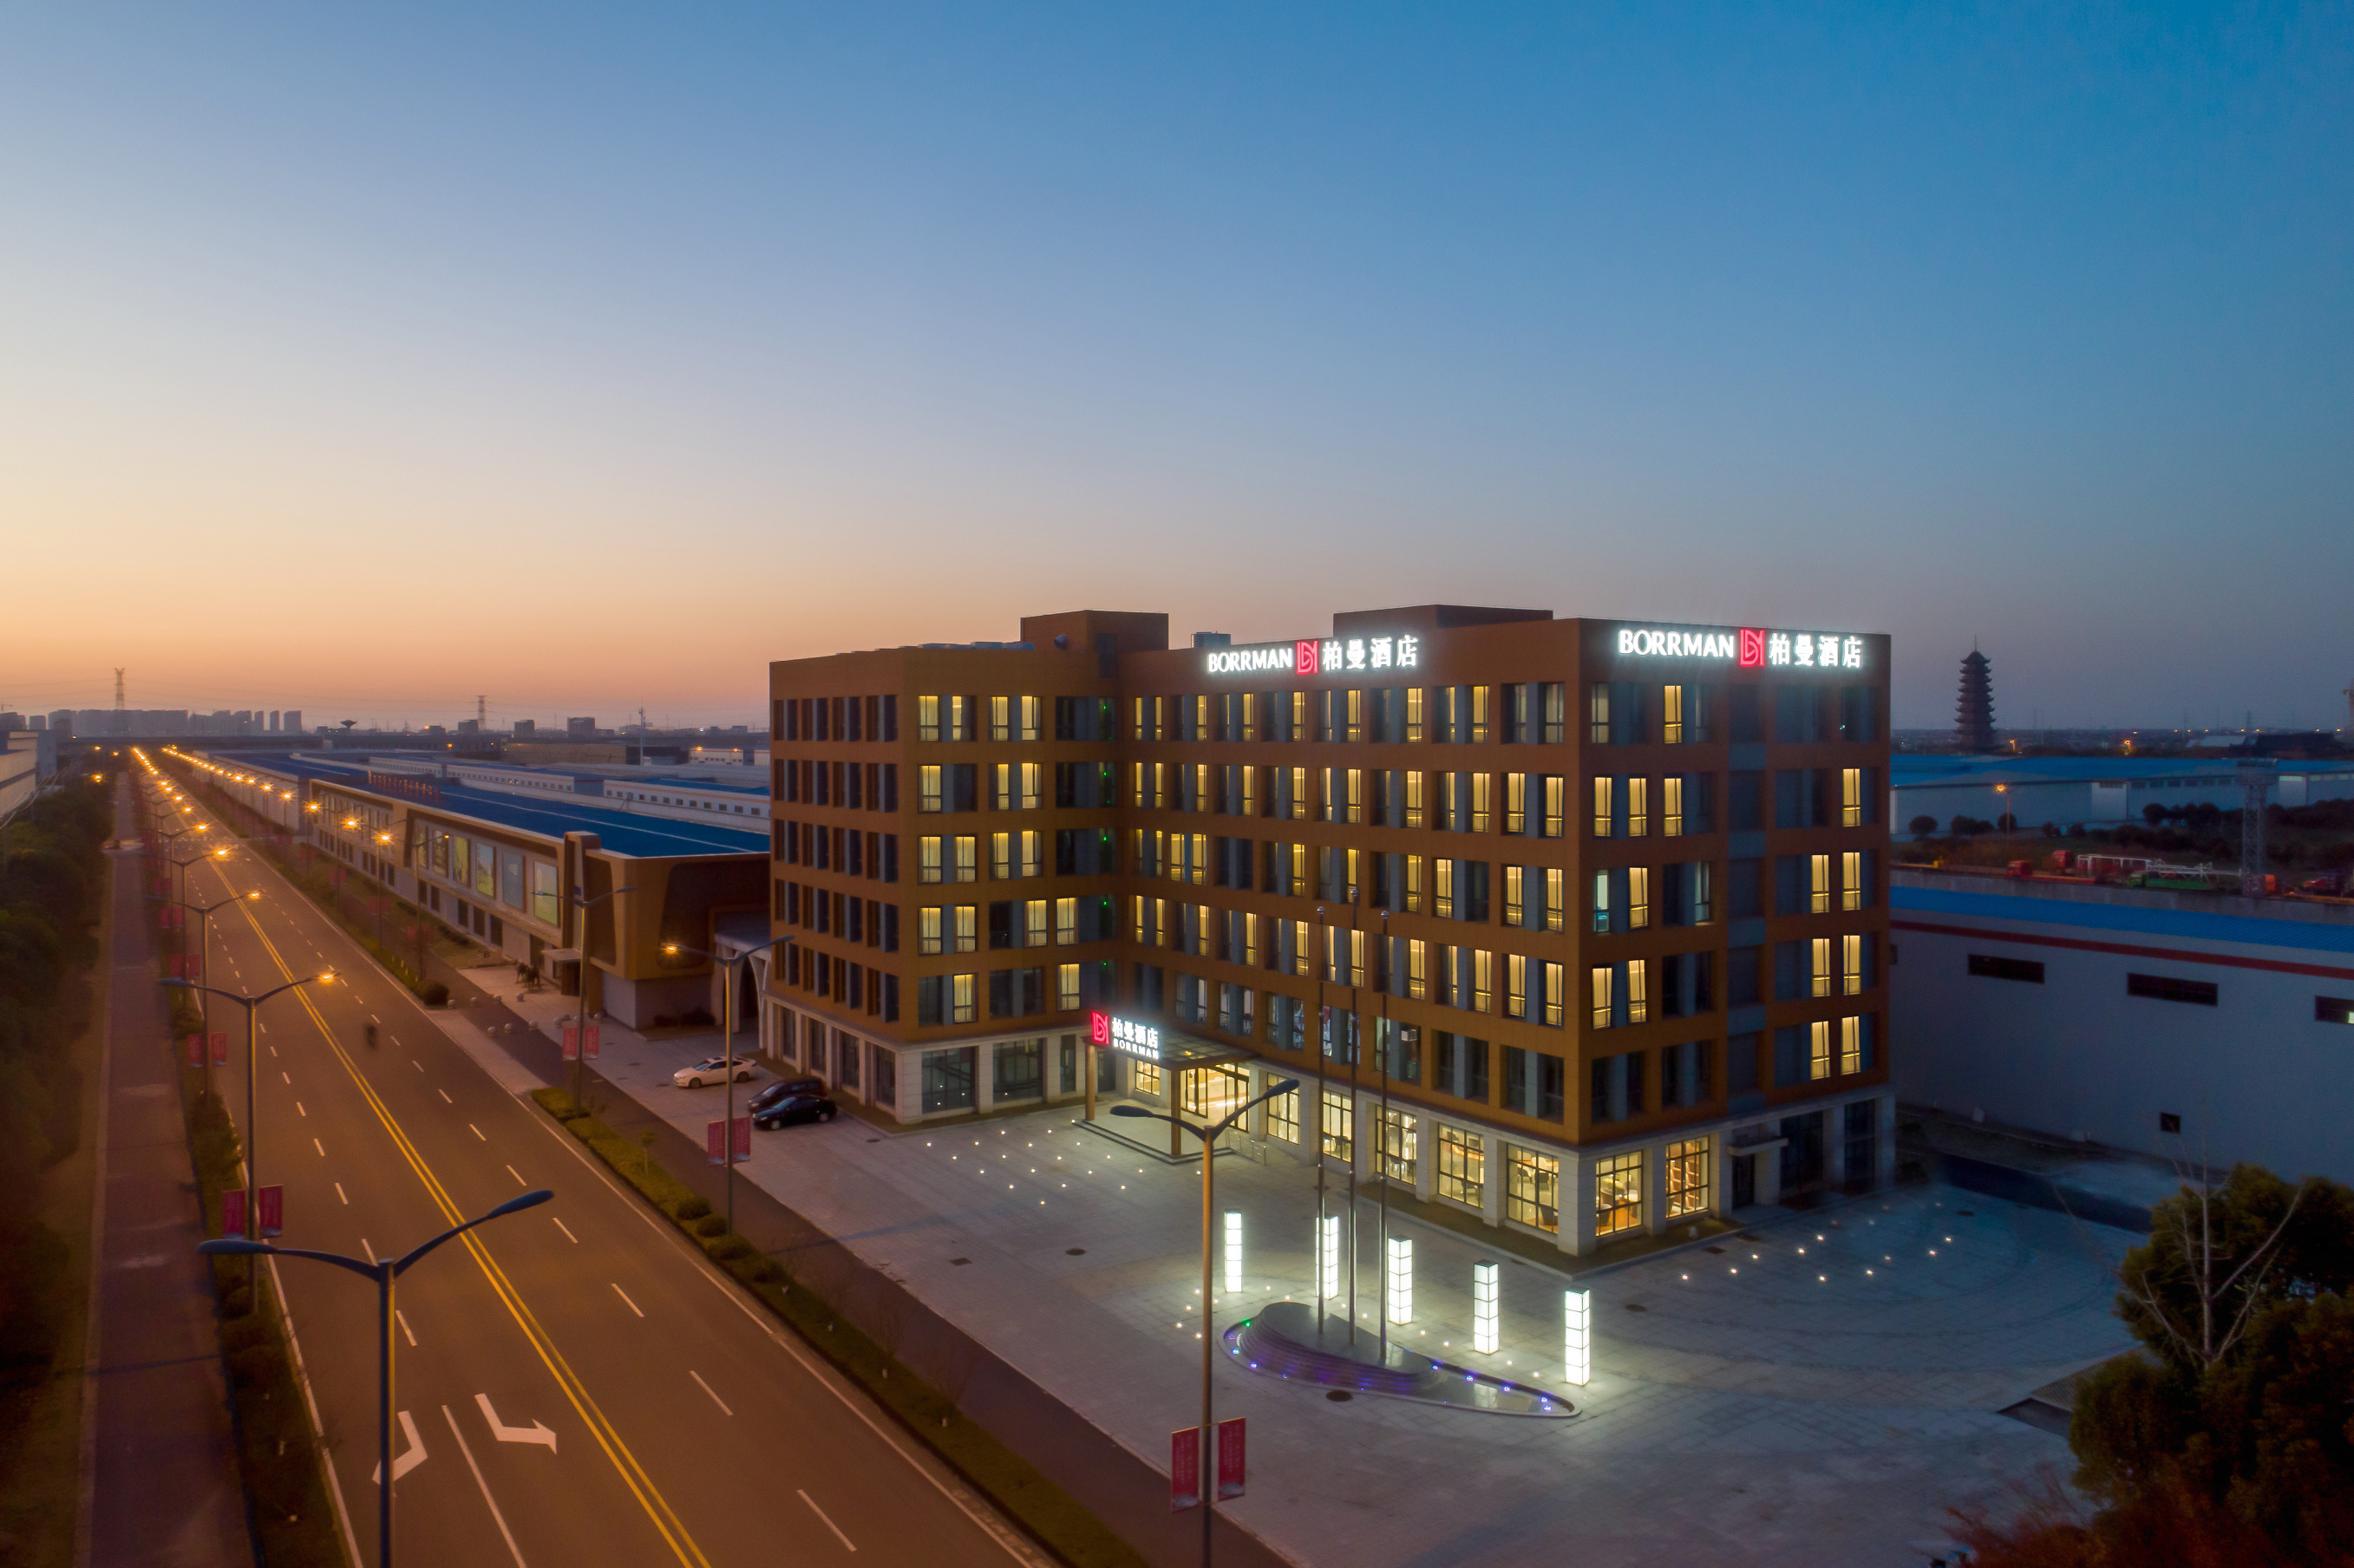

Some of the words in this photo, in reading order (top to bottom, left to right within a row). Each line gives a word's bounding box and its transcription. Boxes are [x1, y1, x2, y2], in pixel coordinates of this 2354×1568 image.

[1323, 634, 1417, 671] 柏曼酒店
[1619, 629, 1734, 657] BORRMAN
[1769, 633, 1862, 668] 柏曼酒店
[1208, 648, 1292, 672] BORRMAN
[1112, 1016, 1159, 1049] 柏曼酒店
[1113, 1038, 1159, 1060] BORRMAN
